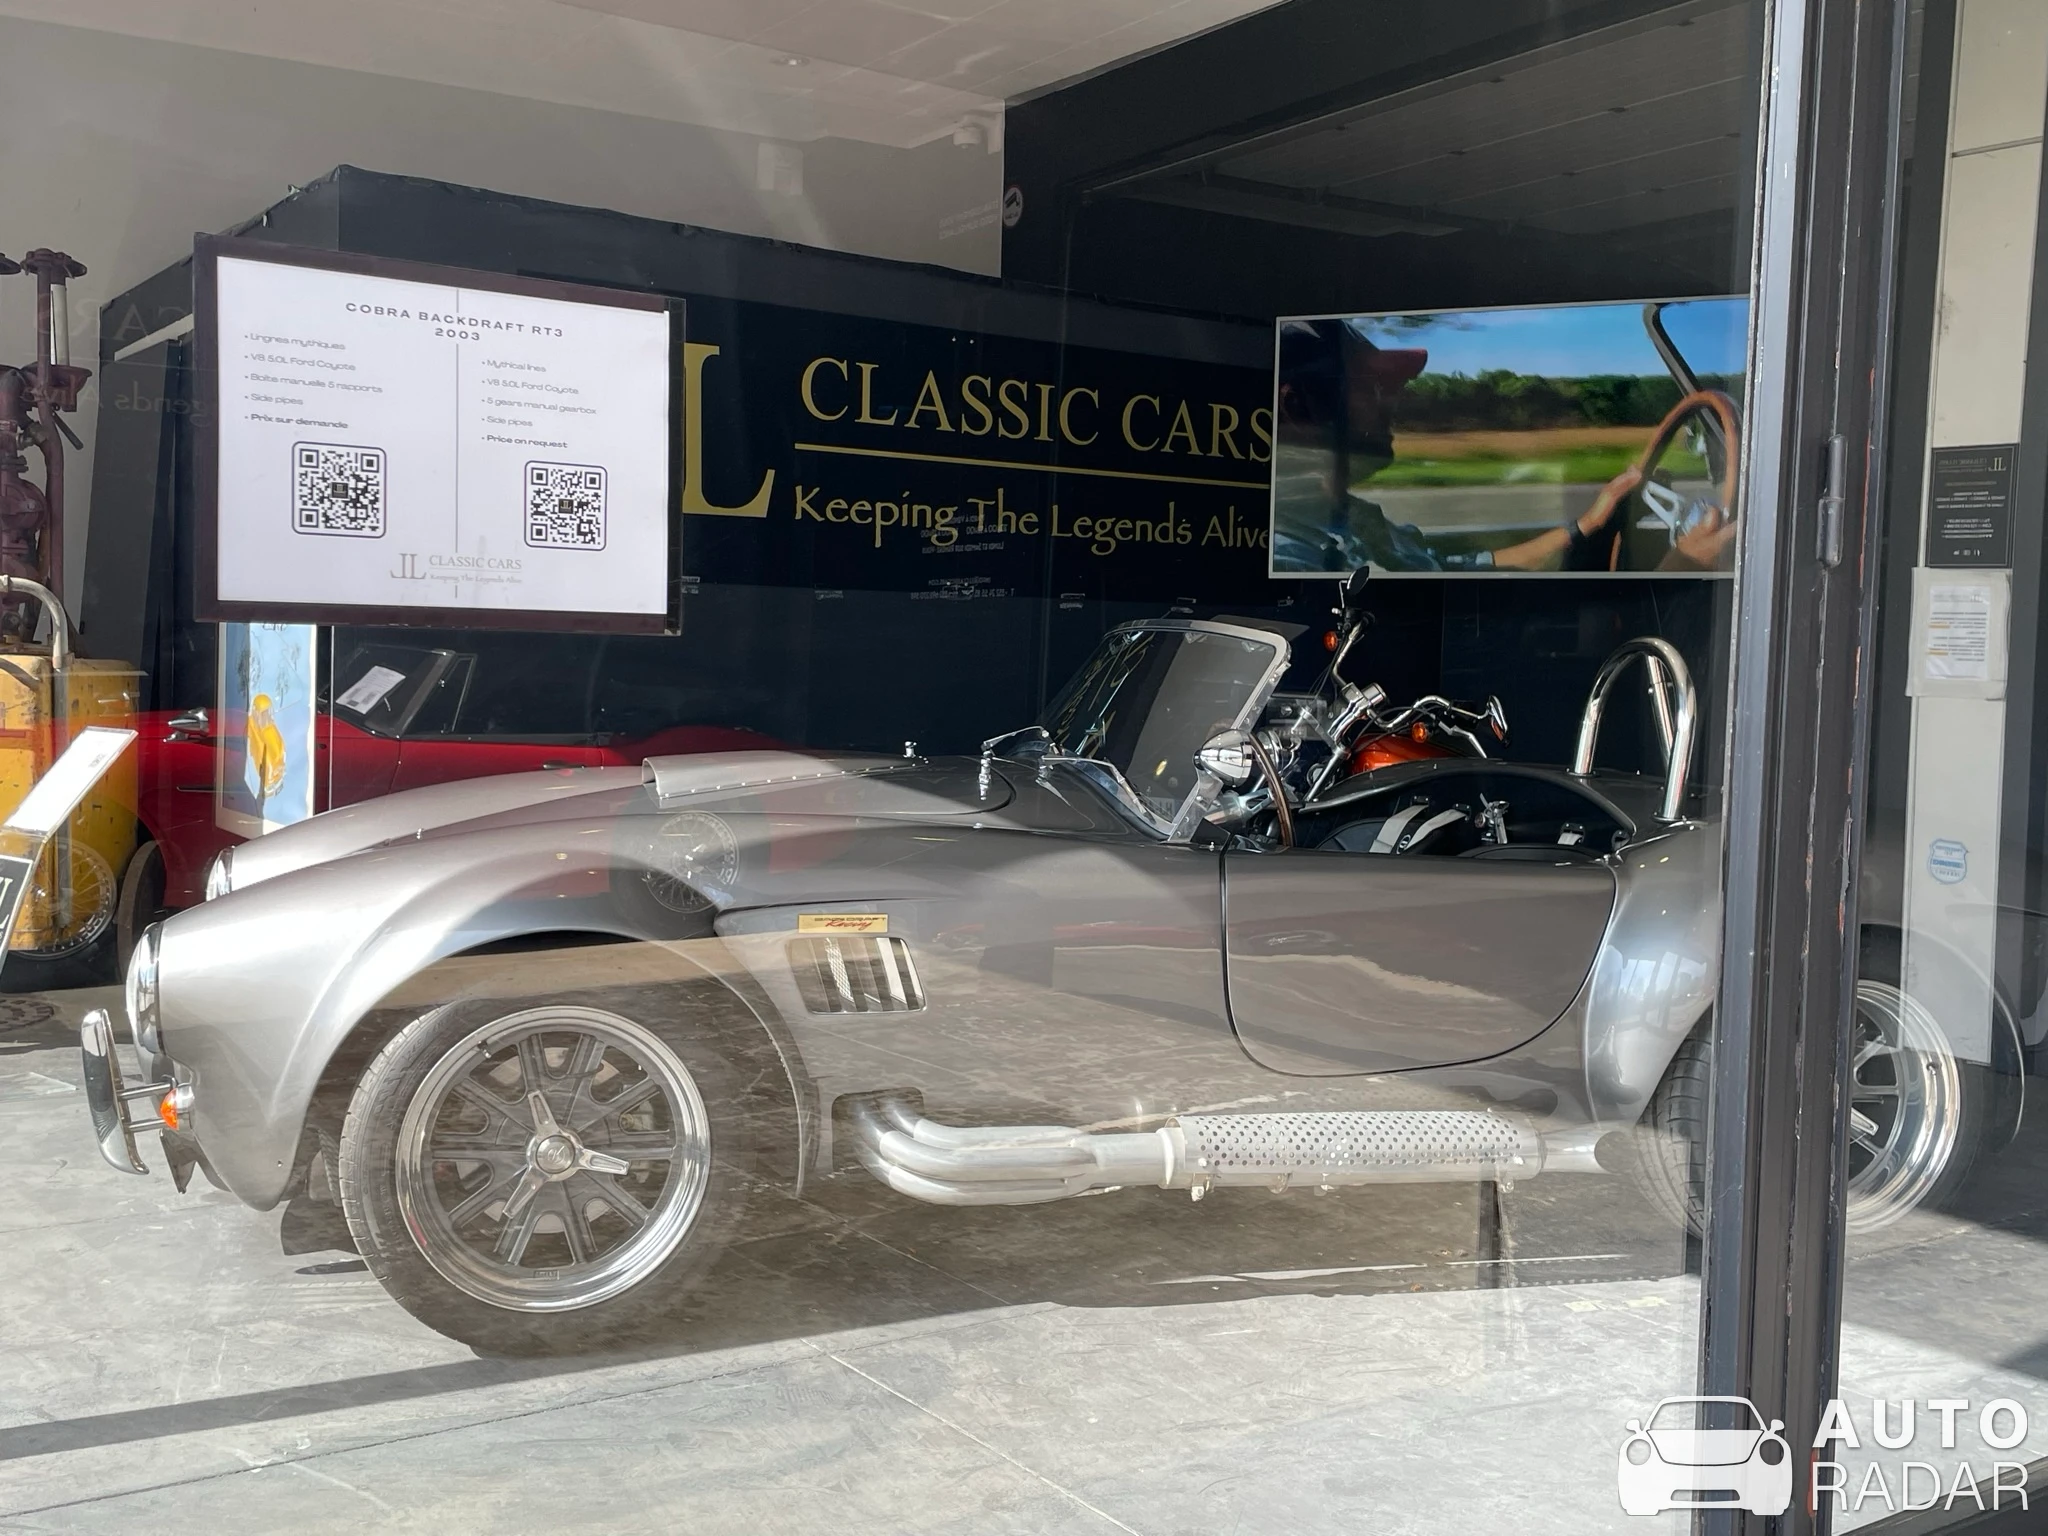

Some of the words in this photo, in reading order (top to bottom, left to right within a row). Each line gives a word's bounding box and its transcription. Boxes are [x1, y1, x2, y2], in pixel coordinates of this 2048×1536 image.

[346, 303, 411, 319] COBRA
[418, 311, 525, 332] BACKDRAFT
[531, 326, 563, 338] RT3
[250, 333, 290, 344] Lingnes
[291, 338, 346, 350] mythiques
[435, 327, 481, 341] 2003
[251, 353, 266, 362] V8
[290, 357, 315, 367] Ford
[316, 359, 356, 371] Coyote
[486, 359, 526, 371] Mythical
[527, 363, 547, 373] lines
[280, 376, 326, 388] manuelle
[328, 381, 335, 389] 5
[336, 383, 384, 394] rapports
[487, 378, 500, 387] V8
[521, 382, 544, 391] Ford
[544, 384, 580, 395] Coyote
[251, 393, 274, 403] Side
[275, 396, 304, 406] pipes
[487, 397, 494, 405] 5
[495, 399, 523, 408] gears
[524, 401, 558, 411] manual
[559, 404, 597, 415] gearbox
[800, 357, 1101, 446] CLASSIC
[1121, 394, 1274, 463] CARS
[251, 413, 274, 423] Prix
[295, 418, 349, 429] demande
[486, 415, 507, 425] Side
[508, 418, 533, 428] pipes
[683, 341, 776, 519] L
[487, 434, 513, 444] Price
[528, 439, 568, 449] request
[793, 485, 960, 548] Keeping
[967, 488, 1040, 535] The
[1051, 501, 1193, 556] Legends
[429, 554, 486, 569] CLASSIC
[487, 557, 522, 570] CARS
